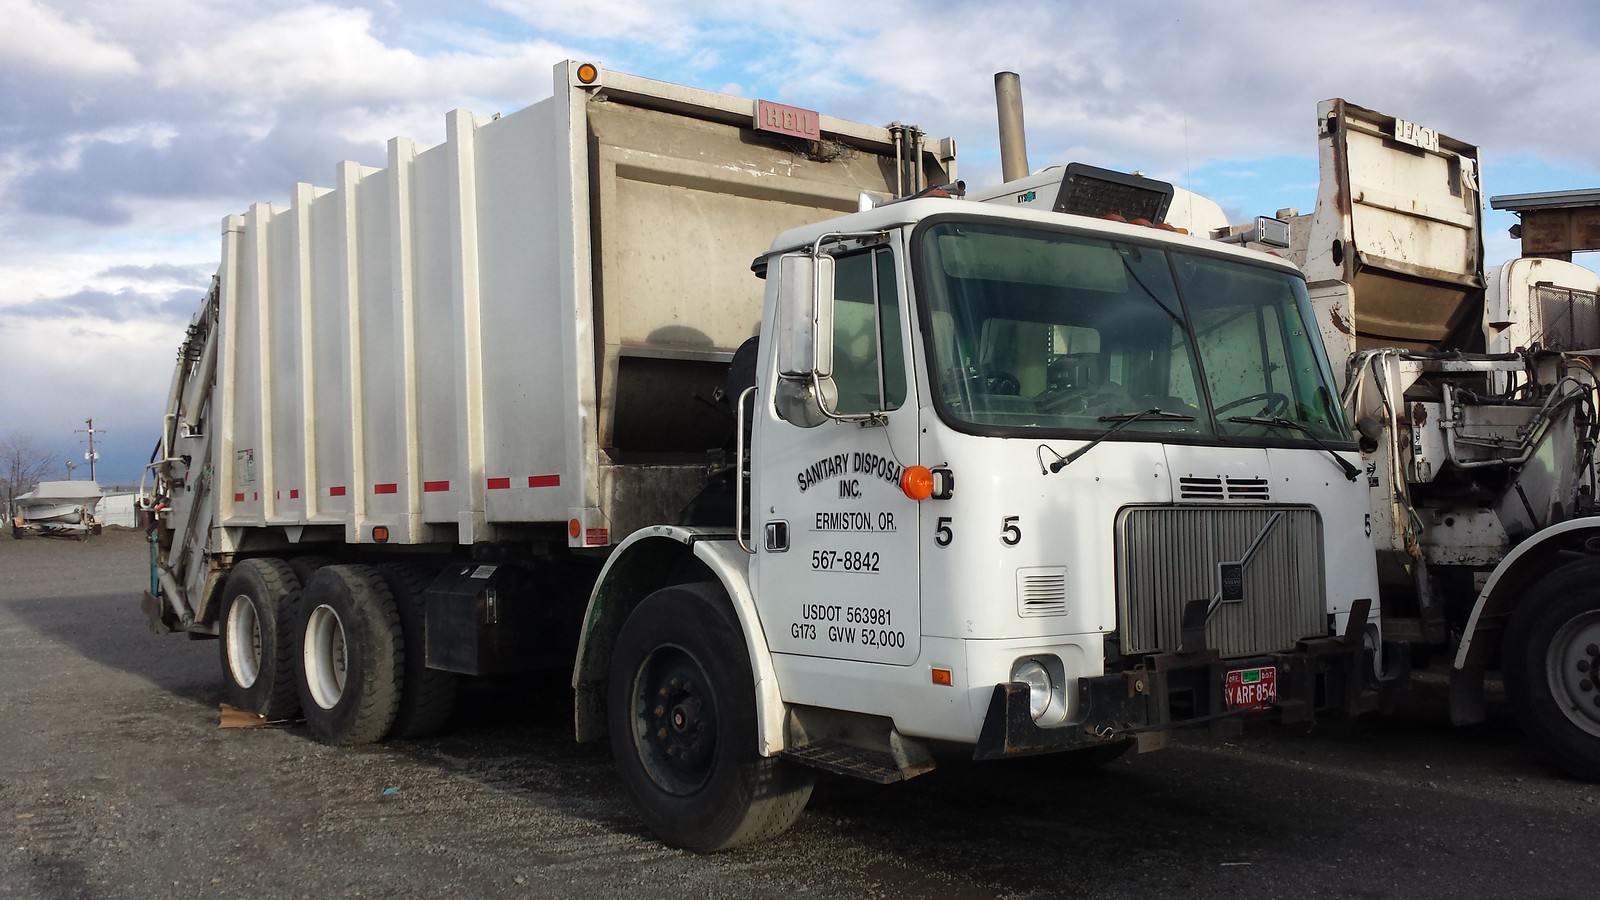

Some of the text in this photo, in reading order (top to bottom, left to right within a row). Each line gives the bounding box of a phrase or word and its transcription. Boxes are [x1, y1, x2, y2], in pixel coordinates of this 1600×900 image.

[766, 106, 815, 135] HEIL
[1395, 118, 1440, 152] LEACH
[798, 452, 903, 492] SANITARY DISPOSA
[840, 480, 862, 498] INC.
[815, 512, 897, 533] ERMISTON, OR.
[935, 517, 953, 548] 5
[1001, 516, 1022, 547] 5
[1364, 514, 1372, 537] 5
[811, 551, 880, 571] 567-8842
[802, 604, 892, 625] USDOT 563981
[791, 623, 905, 648] G173 GVW 52,000
